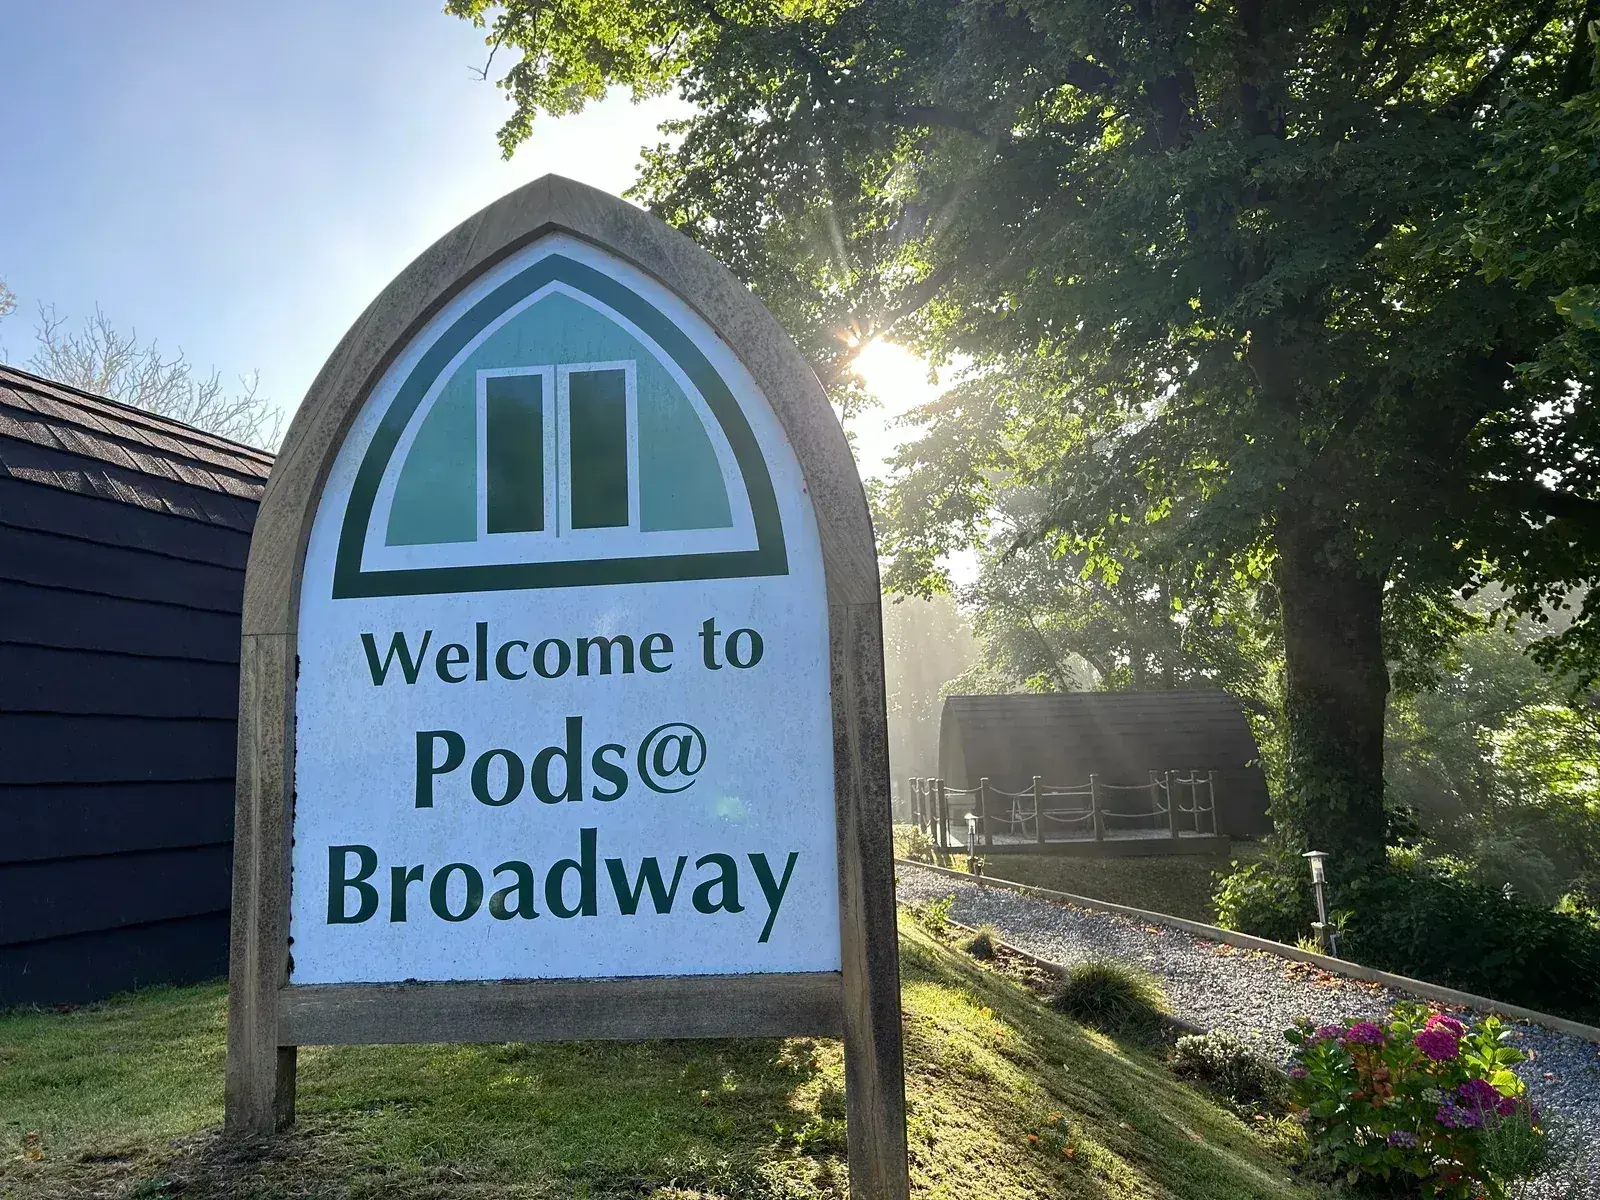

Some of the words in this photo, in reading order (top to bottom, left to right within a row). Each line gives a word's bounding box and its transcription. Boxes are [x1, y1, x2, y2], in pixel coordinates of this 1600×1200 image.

[360, 621, 673, 686] Welcome
[698, 617, 764, 670] to
[414, 715, 708, 809] Pods@
[326, 827, 799, 943] Broadway
